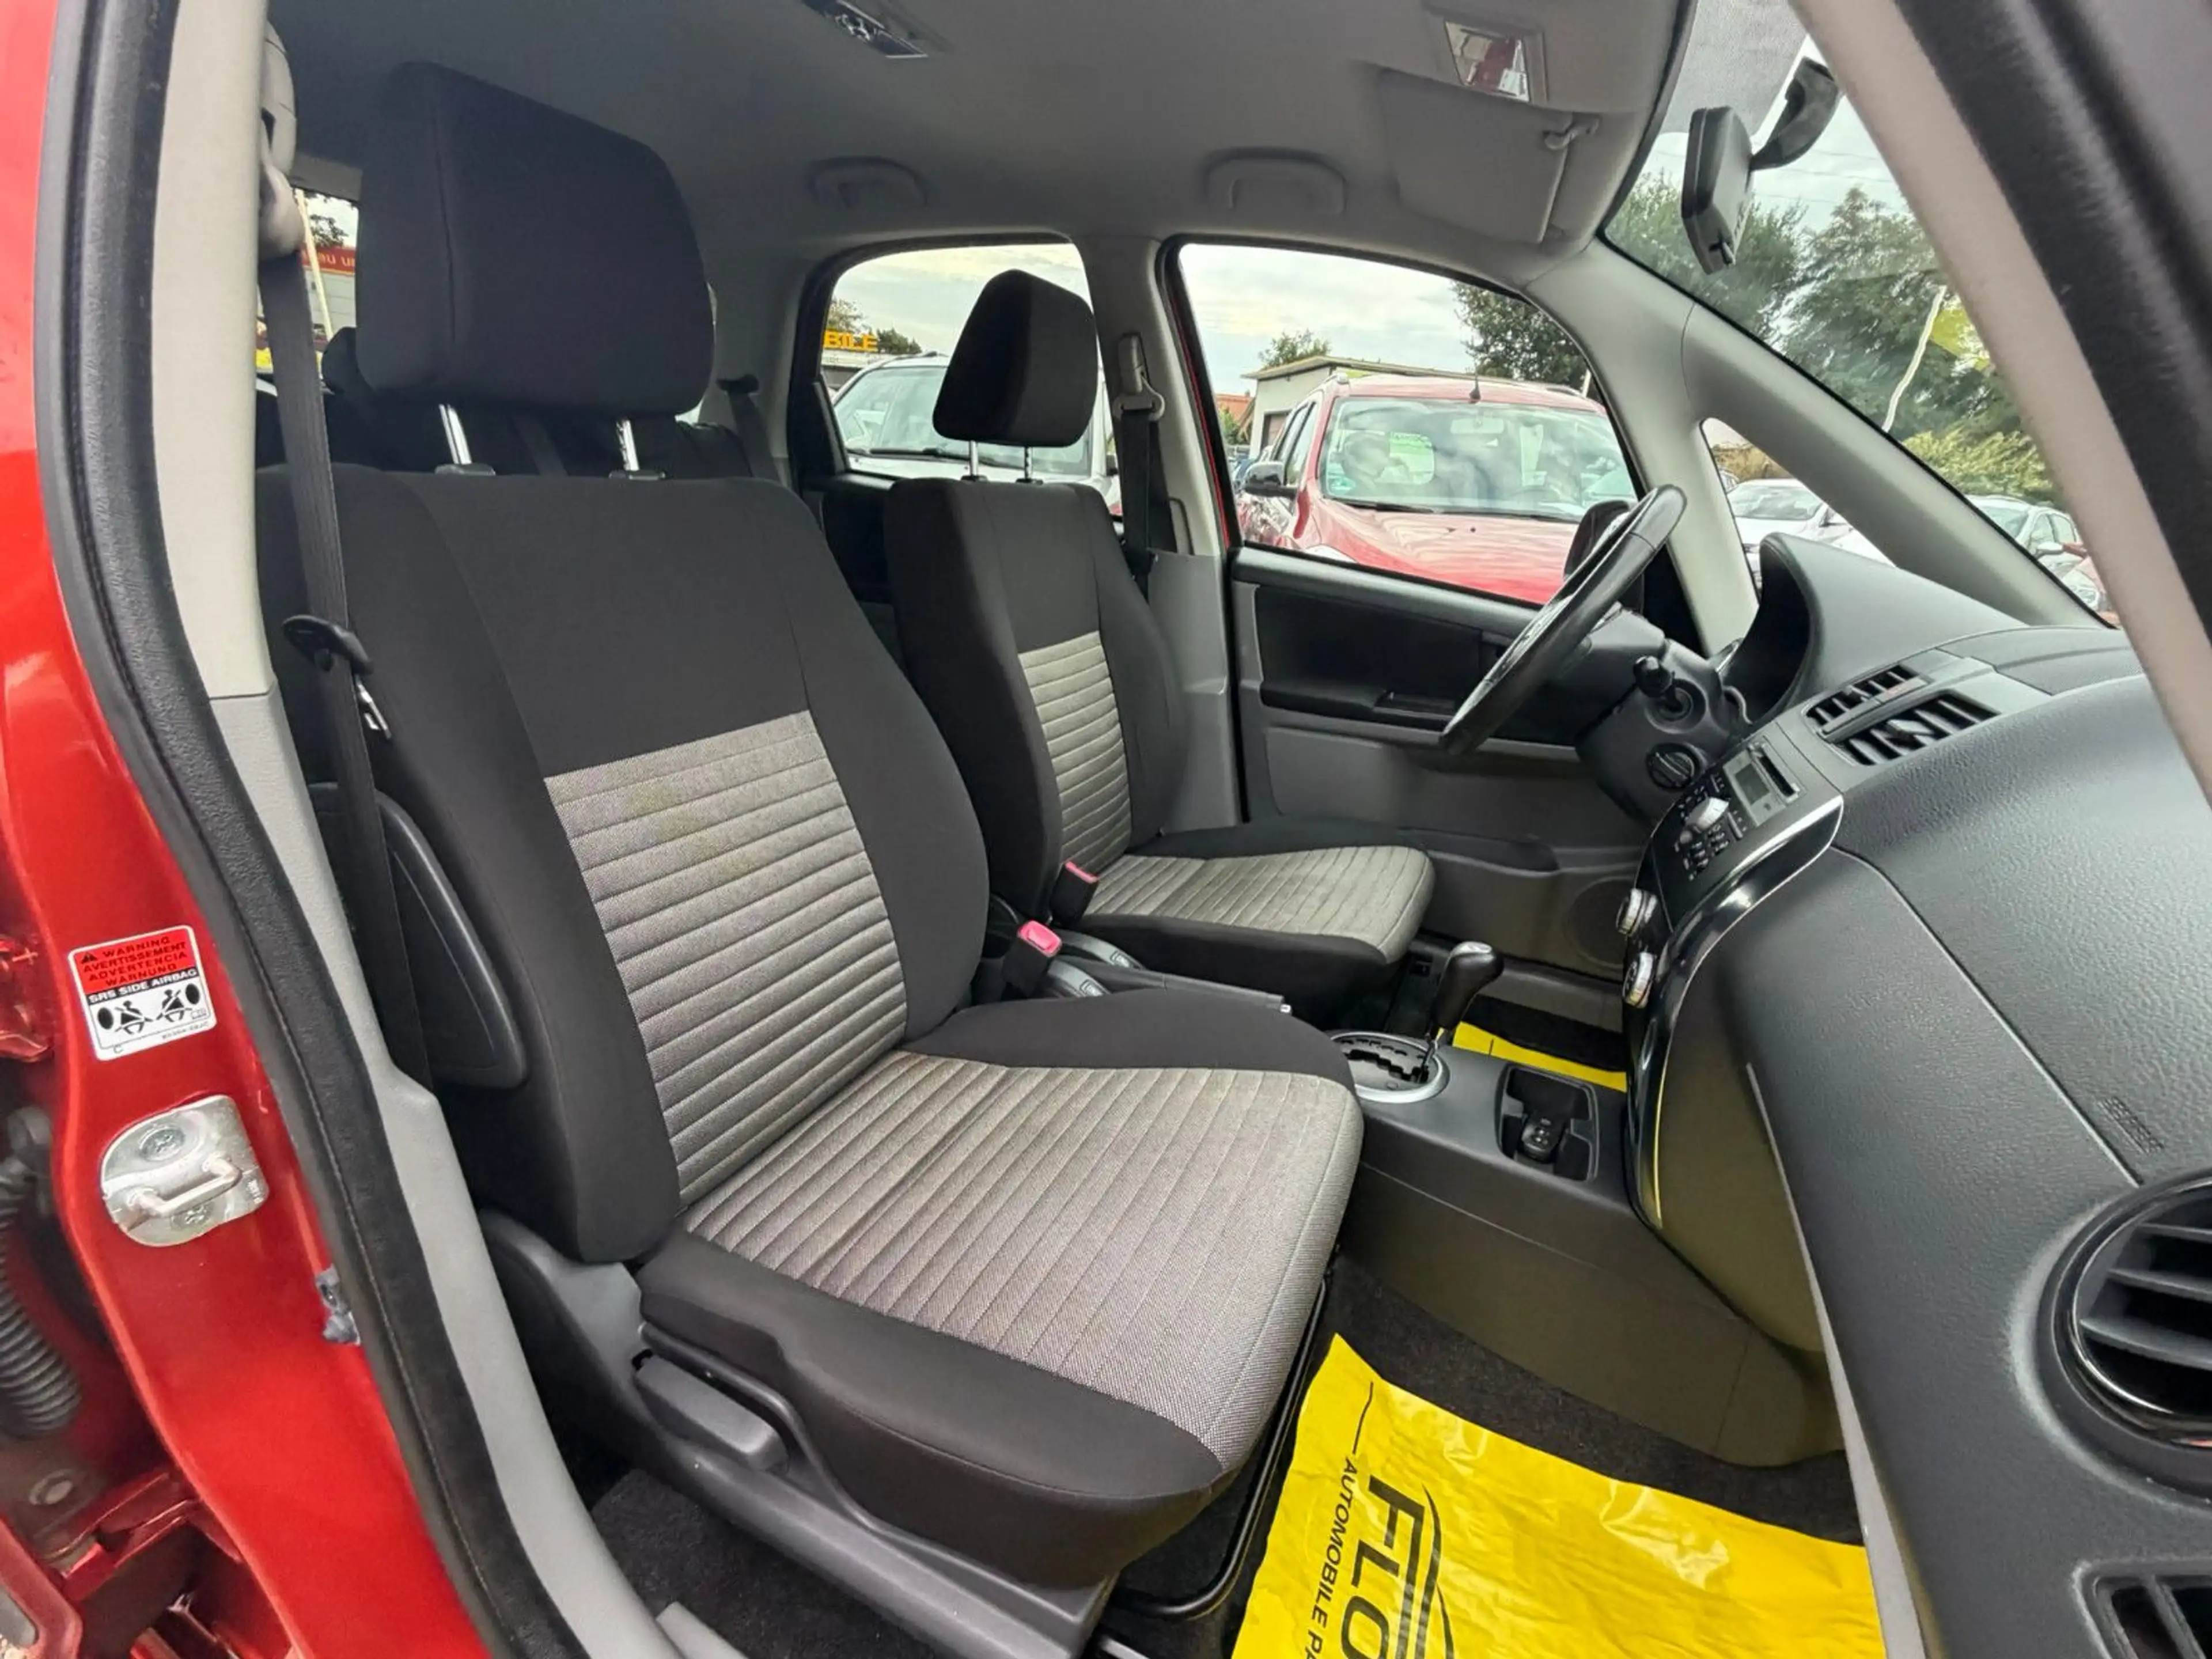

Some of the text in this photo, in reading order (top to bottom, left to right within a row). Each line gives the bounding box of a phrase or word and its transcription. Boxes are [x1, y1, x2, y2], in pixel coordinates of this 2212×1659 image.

[84, 941, 187, 973] AVERTISSEMENT
[103, 936, 171, 957] WARNING
[89, 952, 187, 981] ADVERTENCIA
[105, 964, 177, 986] WARNUNG
[89, 969, 197, 1003] SRS SIDE AIRBAG
[1311, 1457, 1358, 1628] AUTOMOBILE
